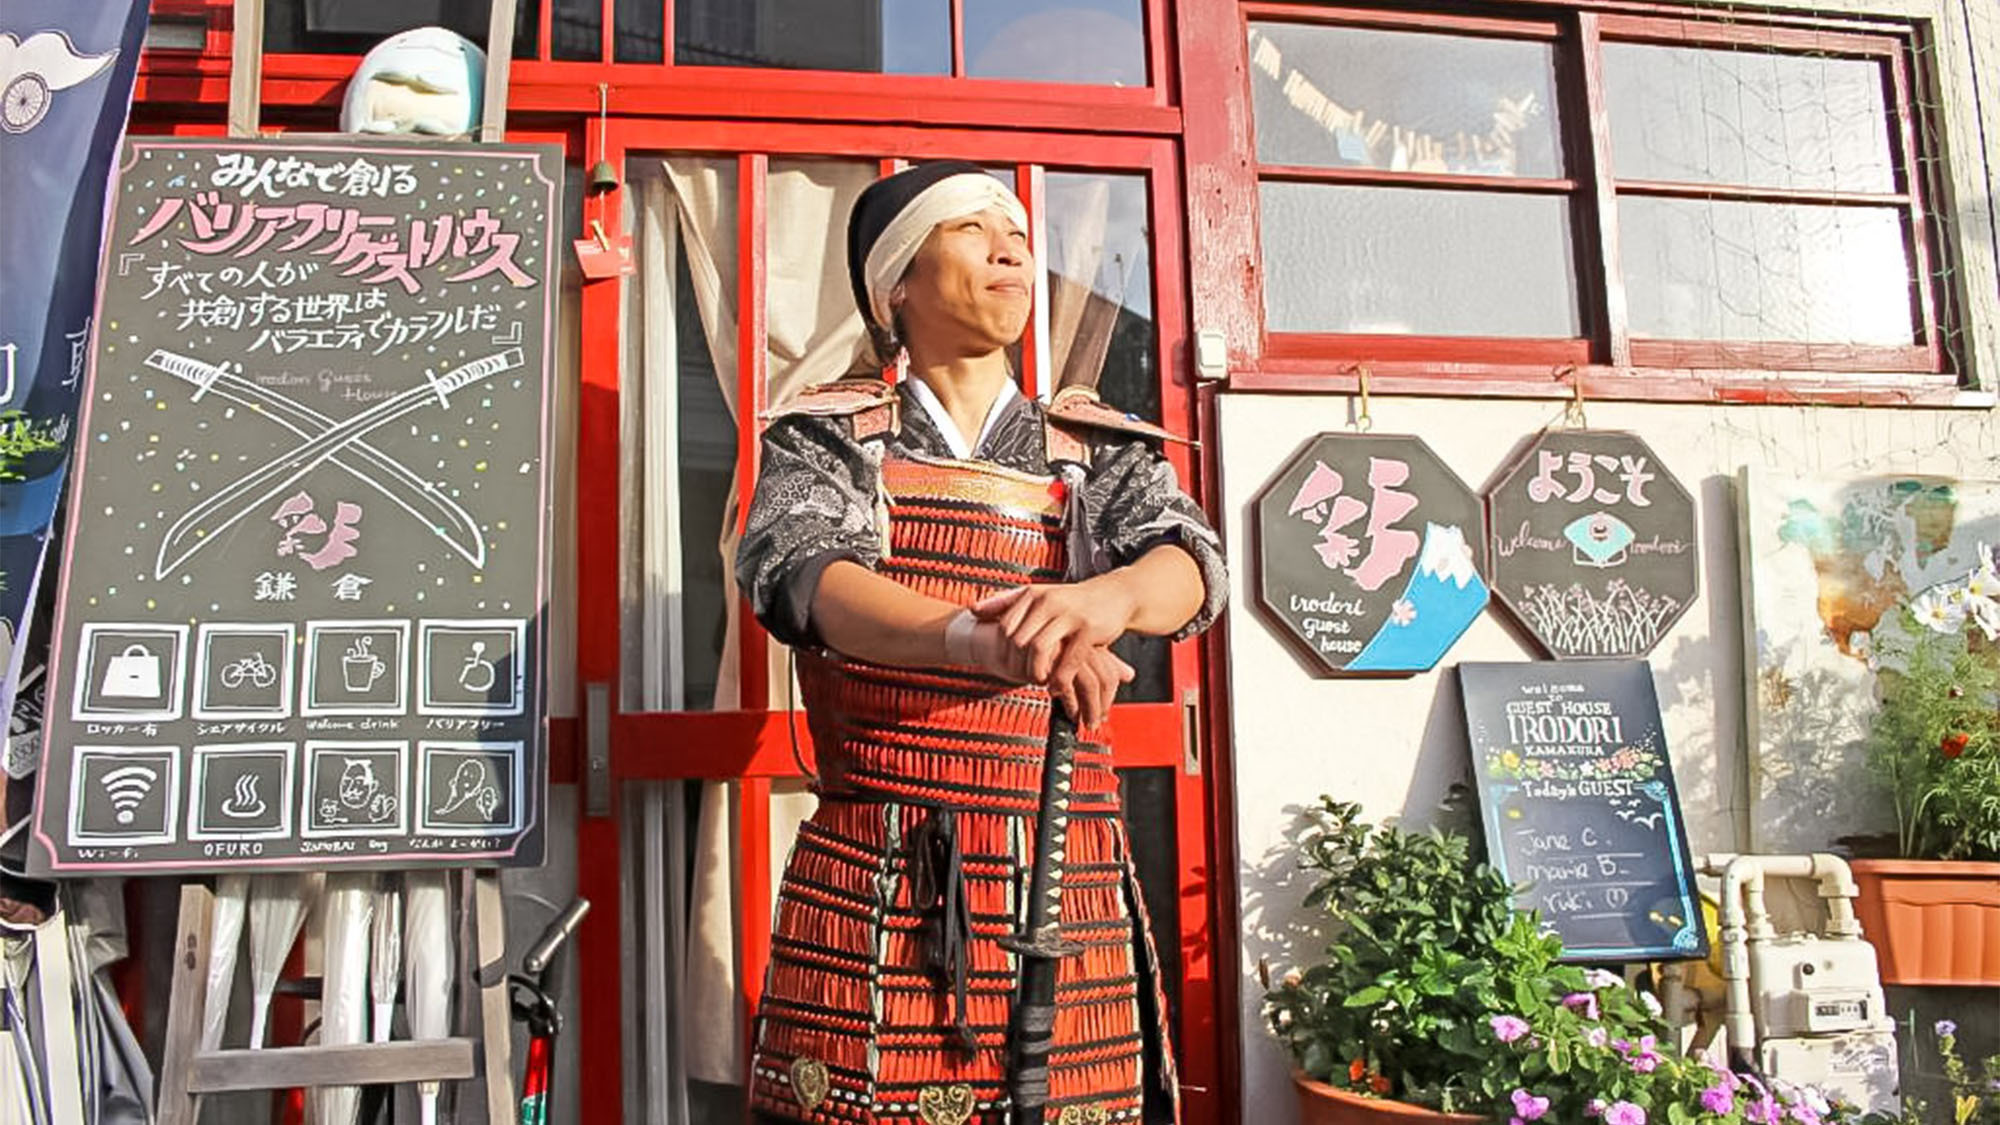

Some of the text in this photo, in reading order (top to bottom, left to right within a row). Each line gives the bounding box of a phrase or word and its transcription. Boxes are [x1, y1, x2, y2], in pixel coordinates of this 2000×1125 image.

[211, 153, 418, 197] みんなで創る
[176, 288, 387, 331] 共創する世界は
[1528, 450, 1655, 506] ようこそ
[1320, 635, 1363, 653] house
[1506, 701, 1612, 716] GUEST HOUSE
[87, 723, 158, 738] ロッカー有
[197, 722, 287, 736] シェアサイクル
[360, 717, 400, 730] drink
[425, 717, 505, 731] バリアフリー
[1507, 714, 1623, 744] IRODORI
[1524, 744, 1604, 756] KAMAKURA
[1578, 779, 1634, 796] GUEST
[204, 842, 264, 856] OFURO
